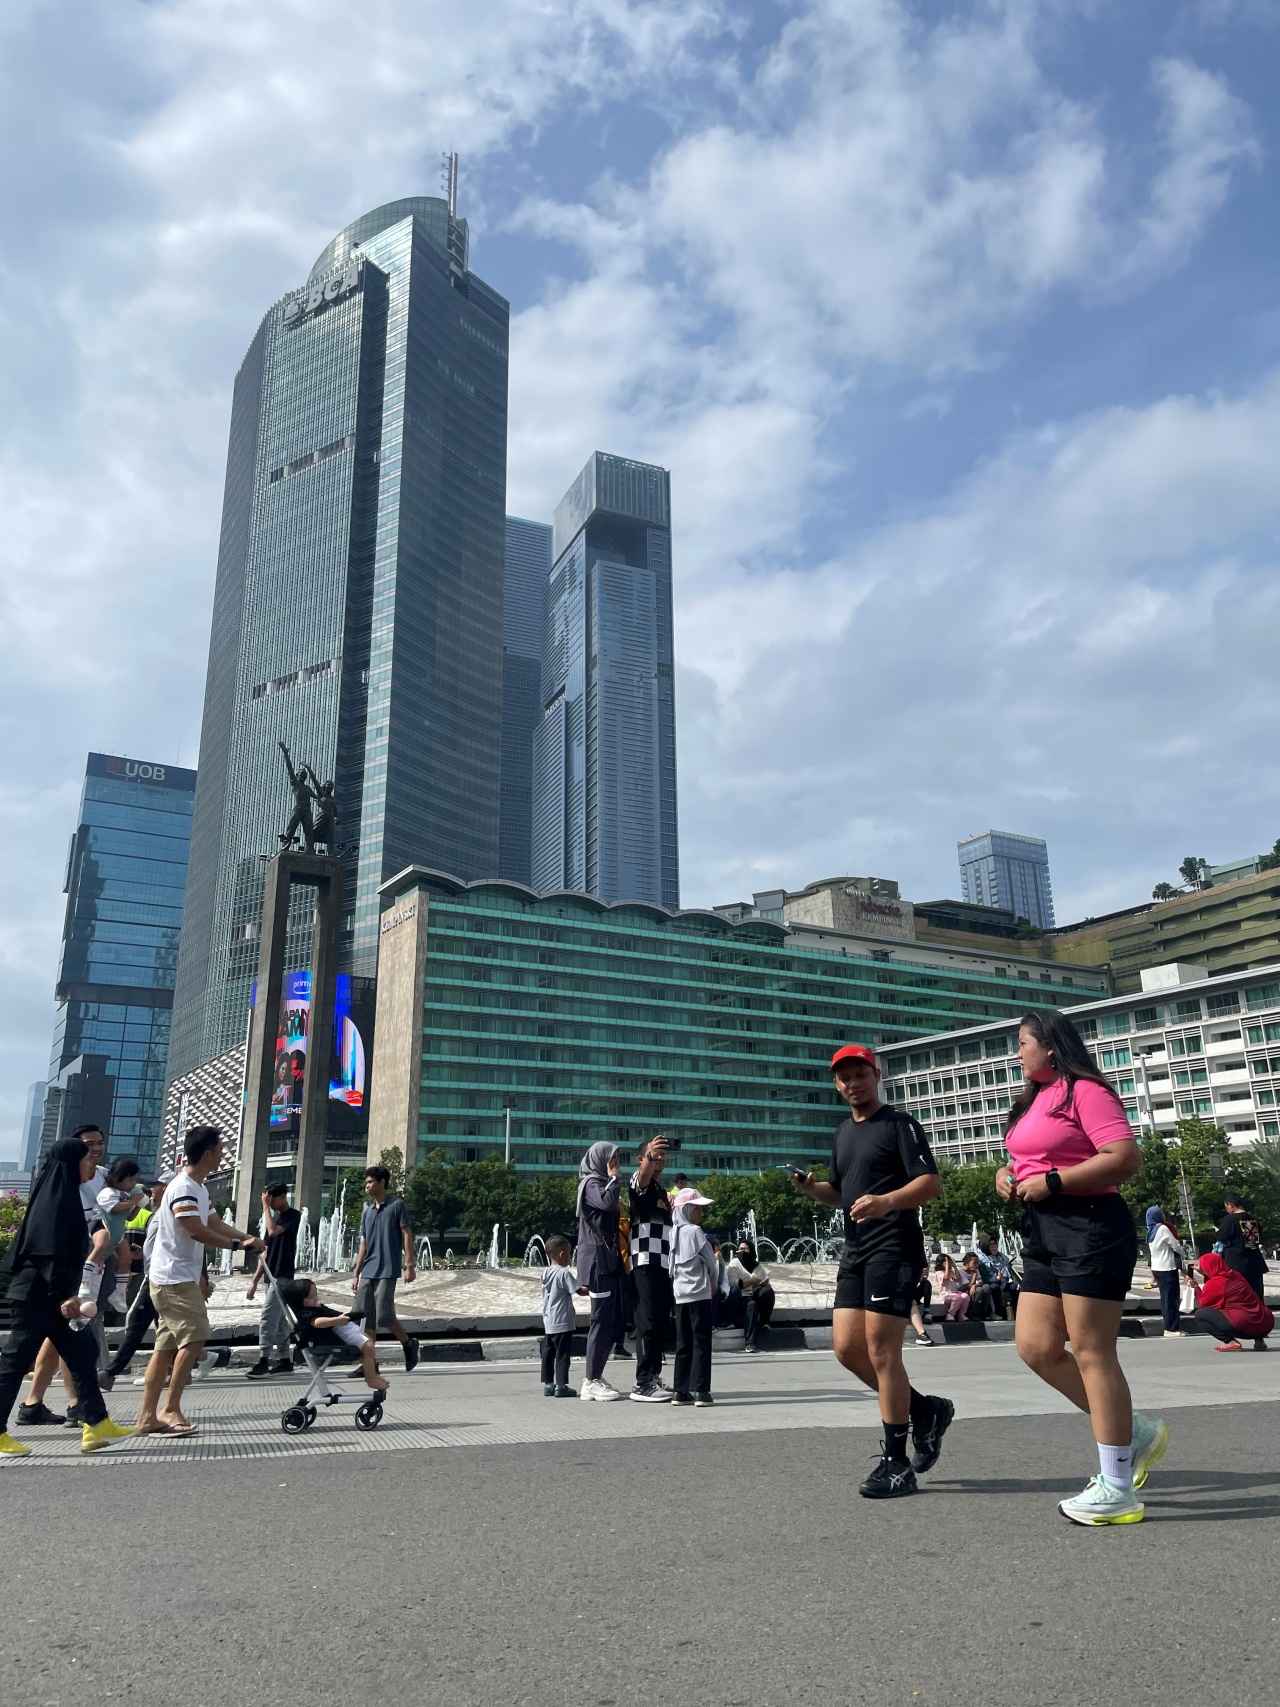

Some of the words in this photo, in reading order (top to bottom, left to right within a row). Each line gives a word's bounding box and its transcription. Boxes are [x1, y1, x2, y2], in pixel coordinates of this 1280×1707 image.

[305, 268, 359, 313] BCA
[125, 762, 166, 781] UOB
[293, 980, 311, 988] prim
